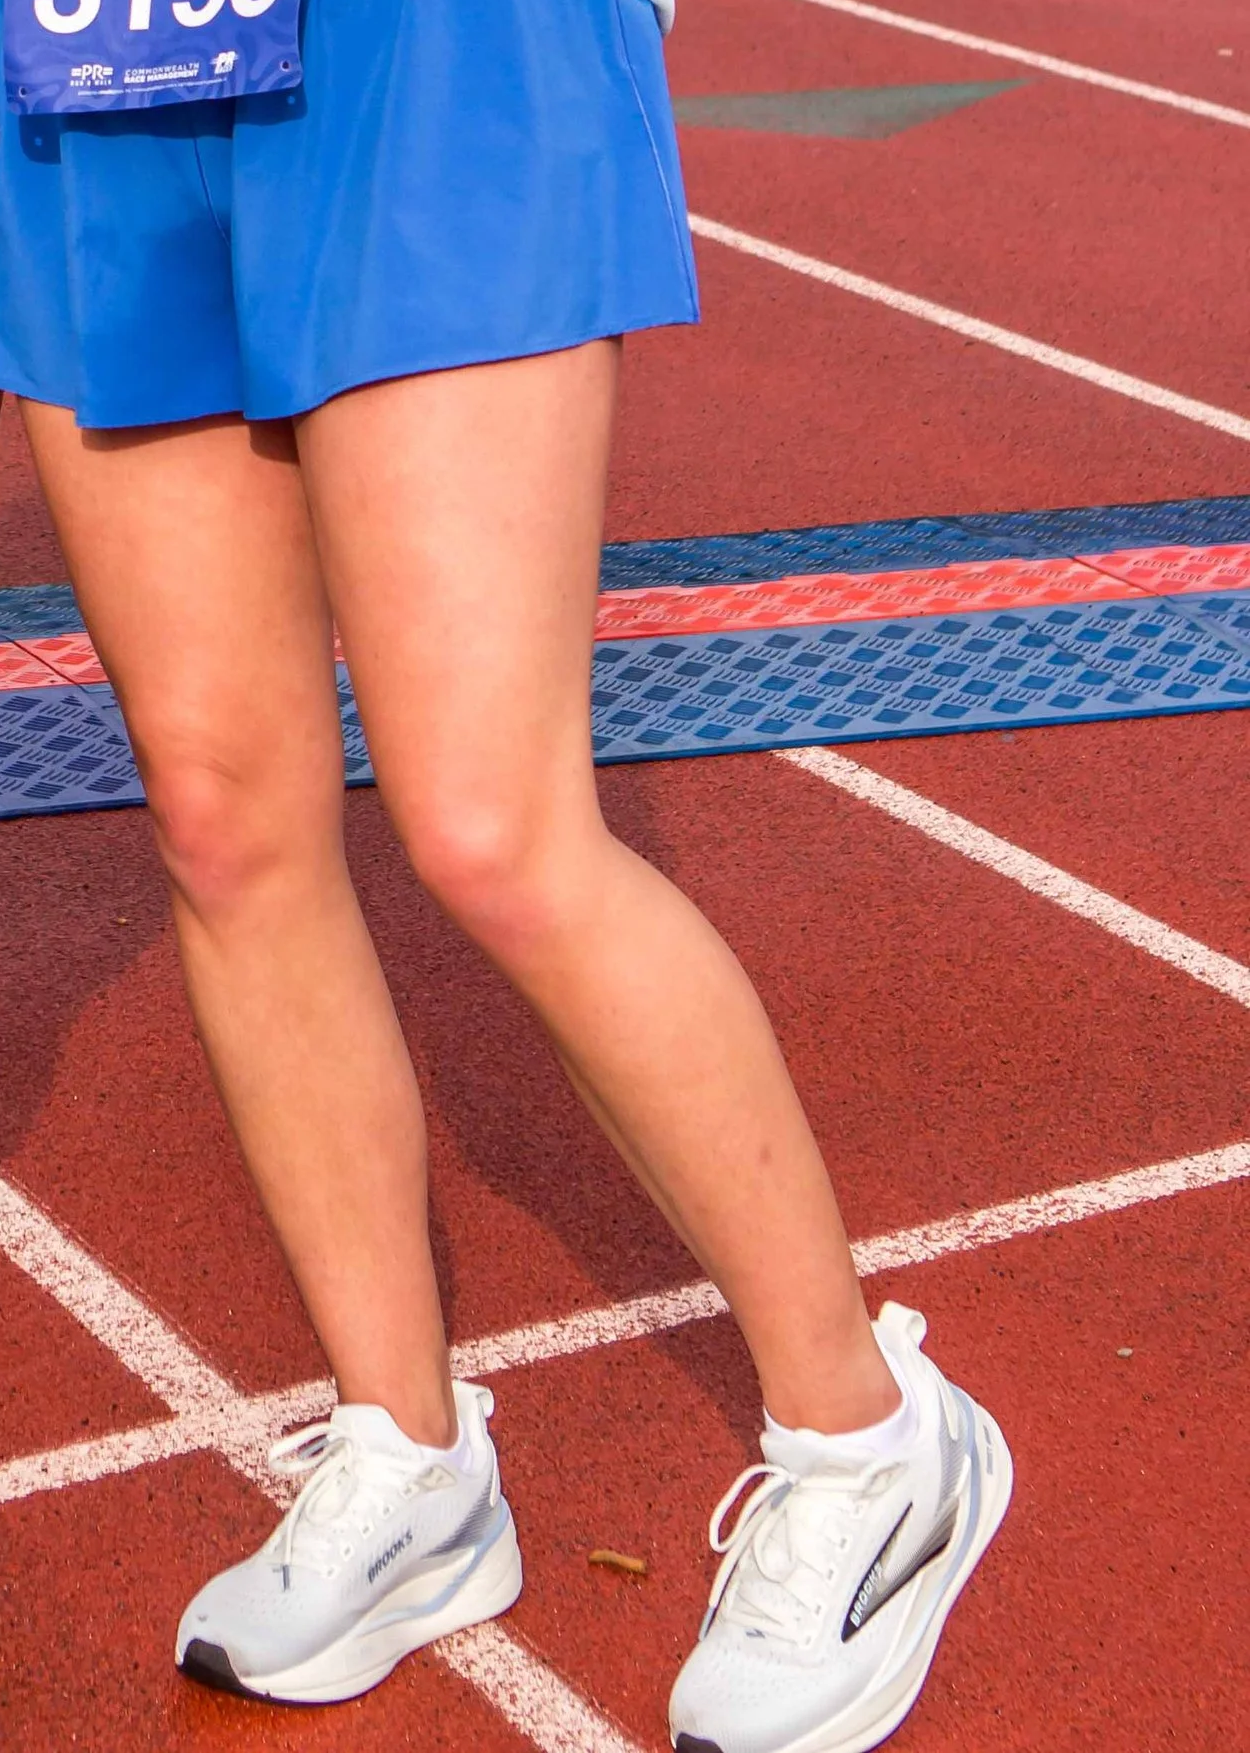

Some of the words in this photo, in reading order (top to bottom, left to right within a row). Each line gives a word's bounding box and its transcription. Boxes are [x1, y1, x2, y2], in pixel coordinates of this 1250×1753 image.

[124, 62, 200, 77] COMMONWEALTH
[124, 75, 146, 84] RACE
[146, 69, 199, 82] MANAGEMENT
[367, 1526, 413, 1584] BROOKS
